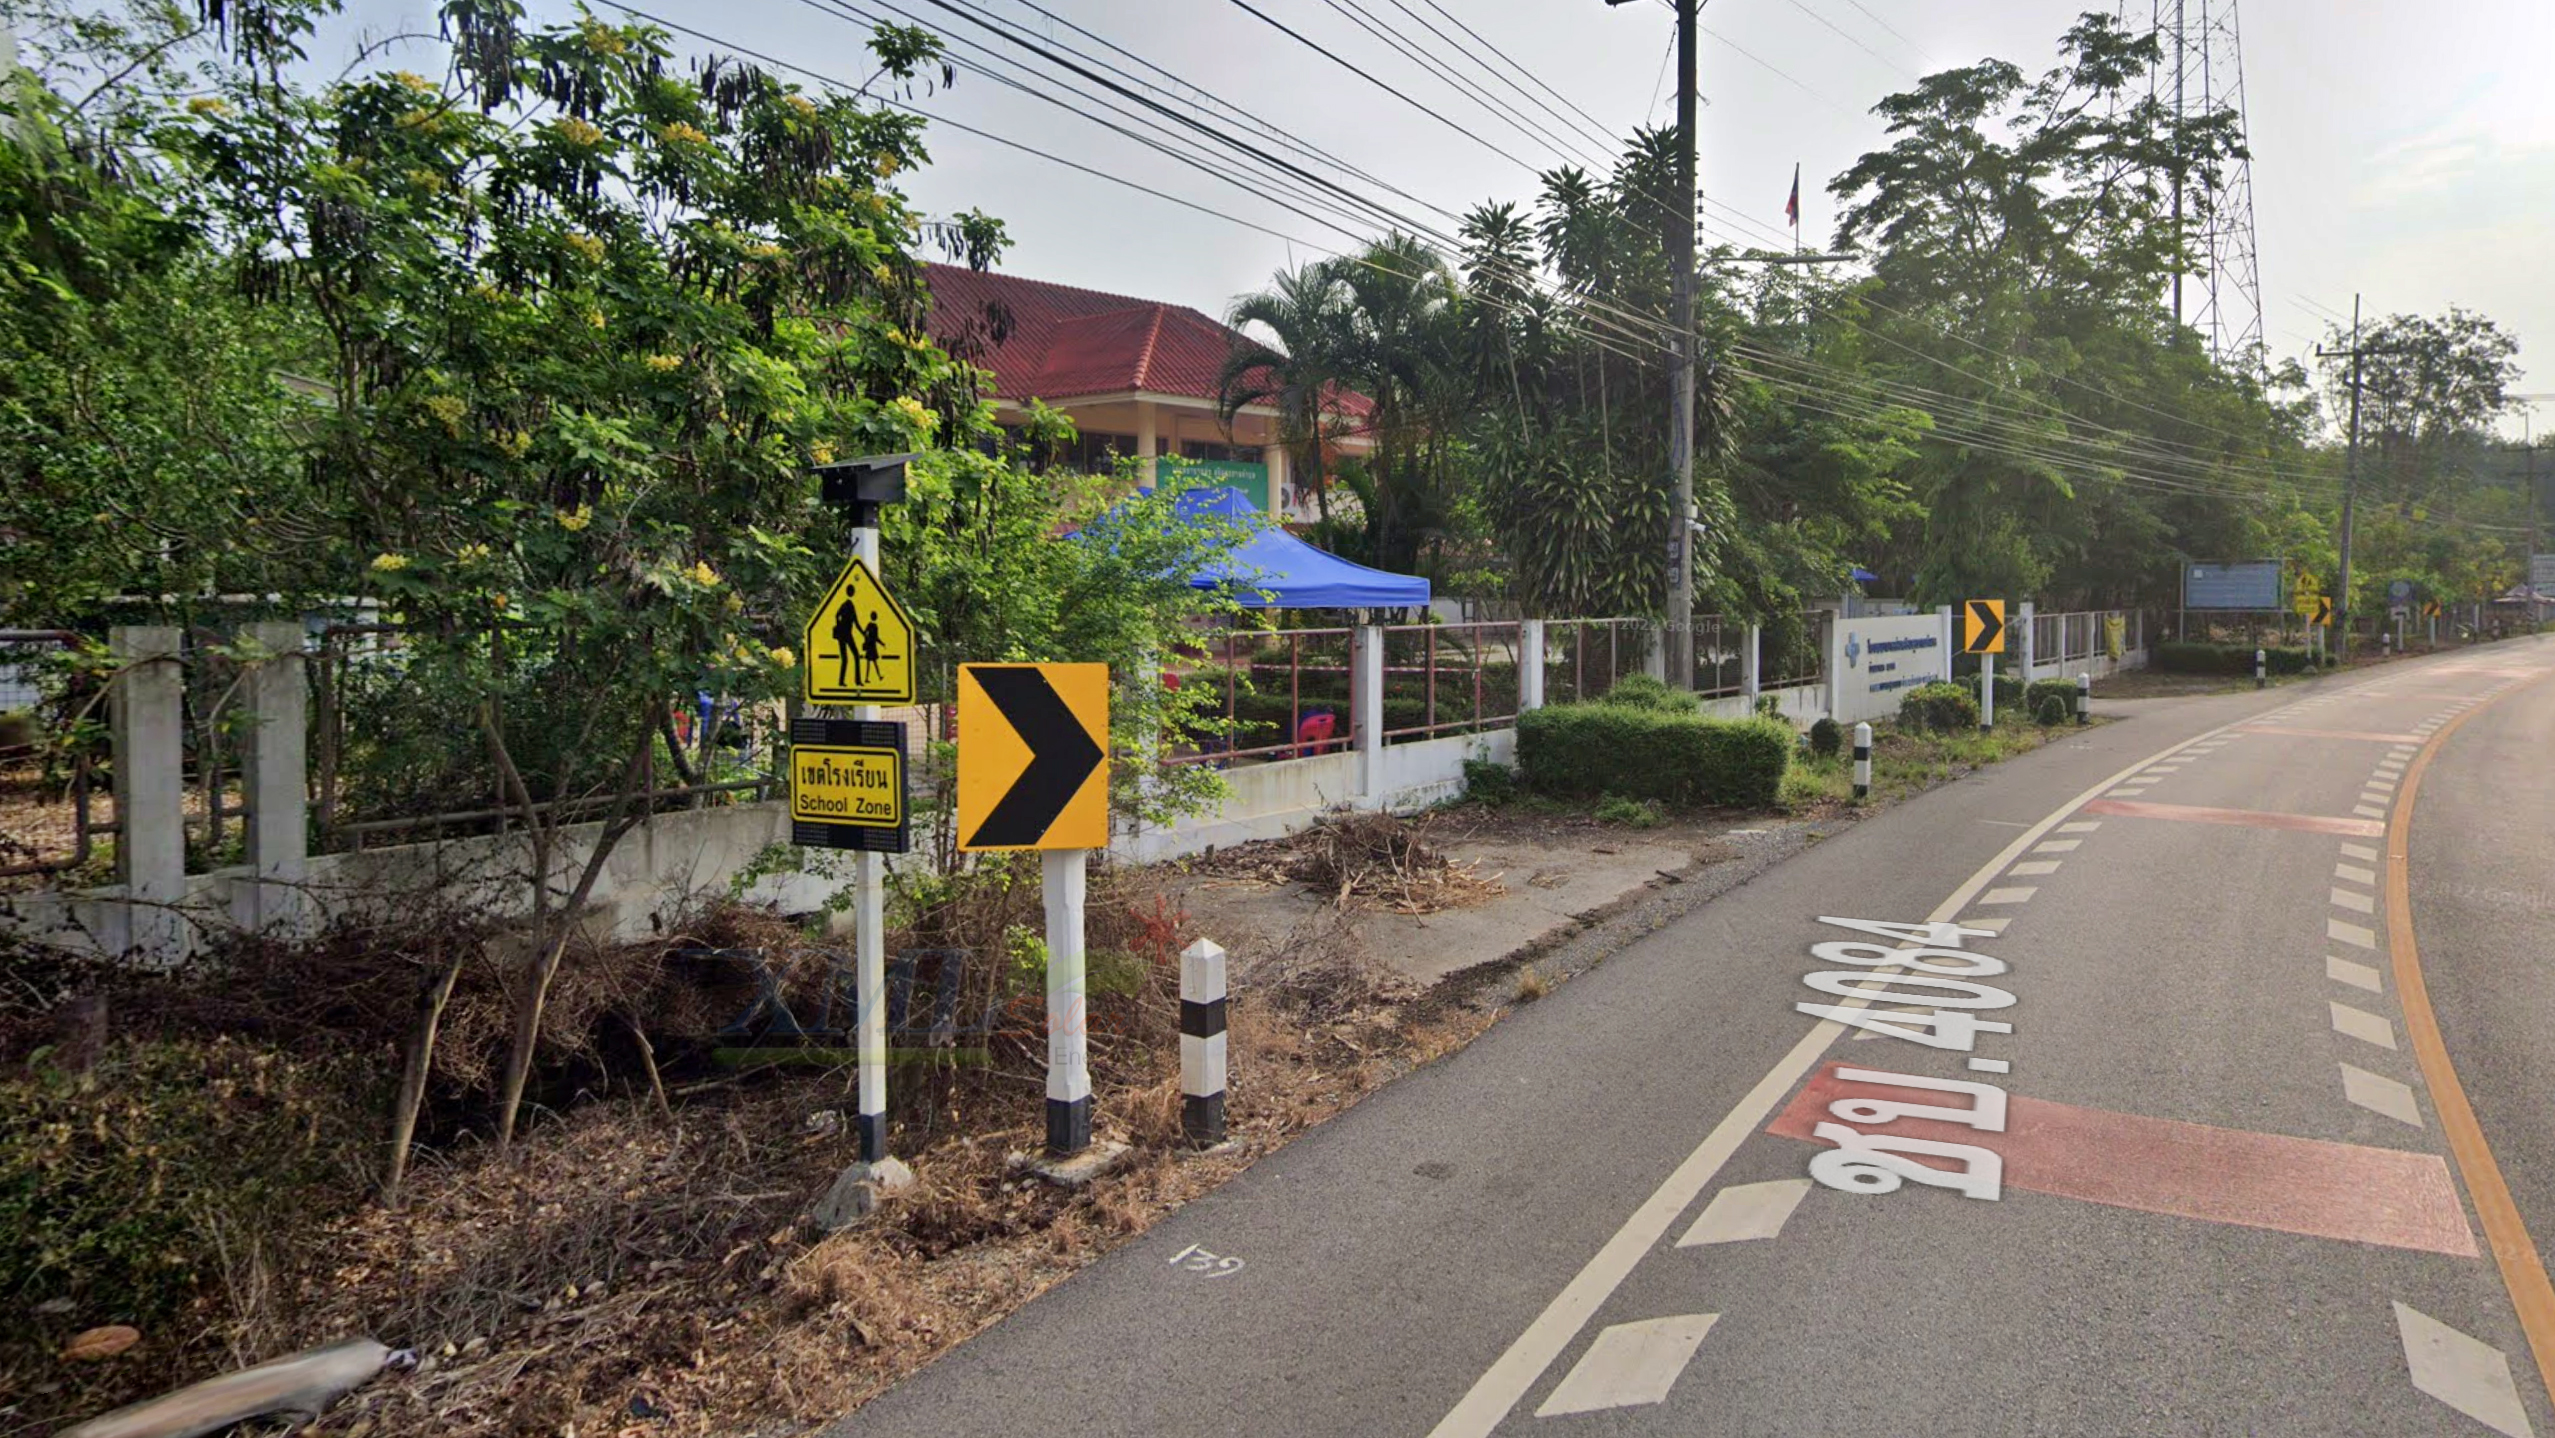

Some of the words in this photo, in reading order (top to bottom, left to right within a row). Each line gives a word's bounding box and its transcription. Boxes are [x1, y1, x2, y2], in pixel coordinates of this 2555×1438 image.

[801, 758, 888, 789] เขตโรงเรียน
[800, 794, 848, 812] School
[855, 797, 892, 815] Zone
